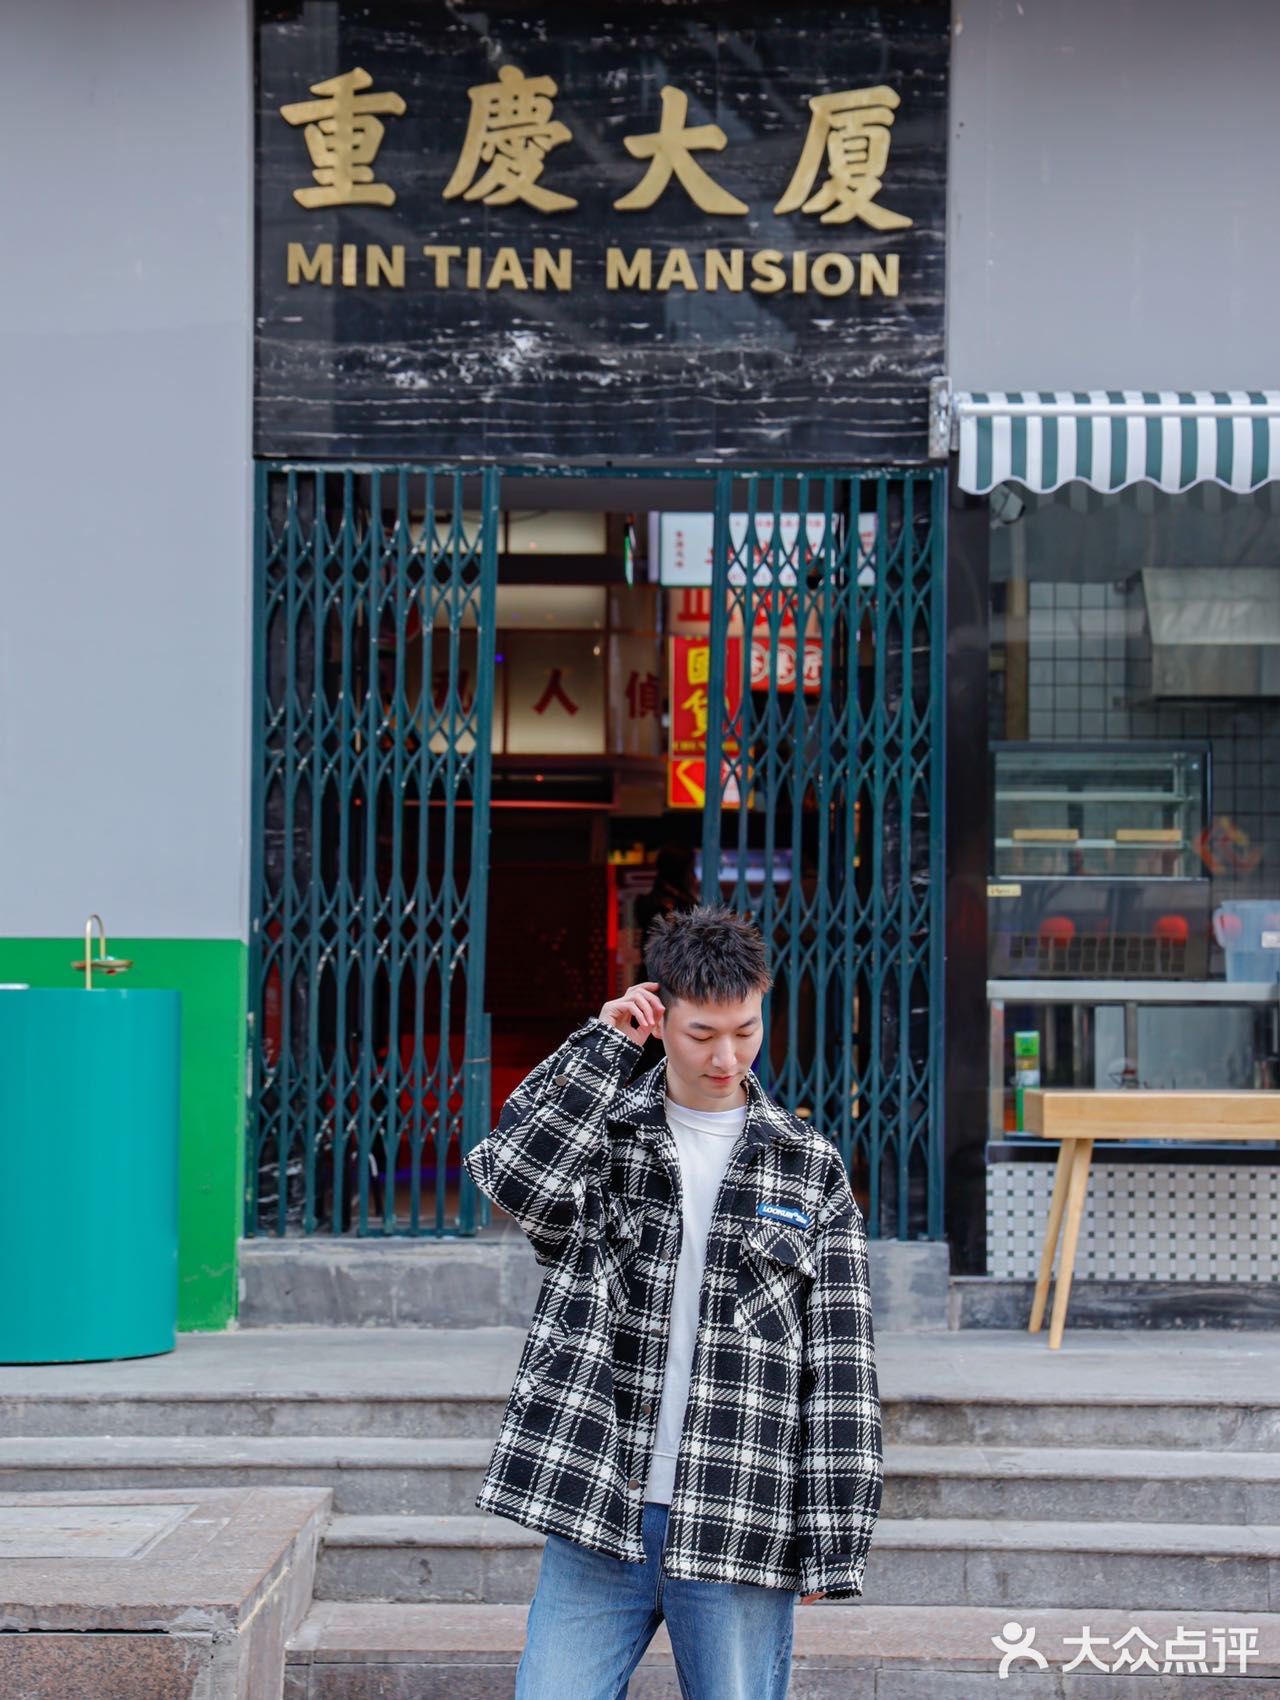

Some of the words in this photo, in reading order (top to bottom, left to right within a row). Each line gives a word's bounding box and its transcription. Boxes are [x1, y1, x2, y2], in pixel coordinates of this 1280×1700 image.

[280, 65, 912, 231] 重慶大厦
[286, 243, 406, 288] MIN
[424, 245, 573, 291] TIAN
[605, 247, 900, 297] MANSION
